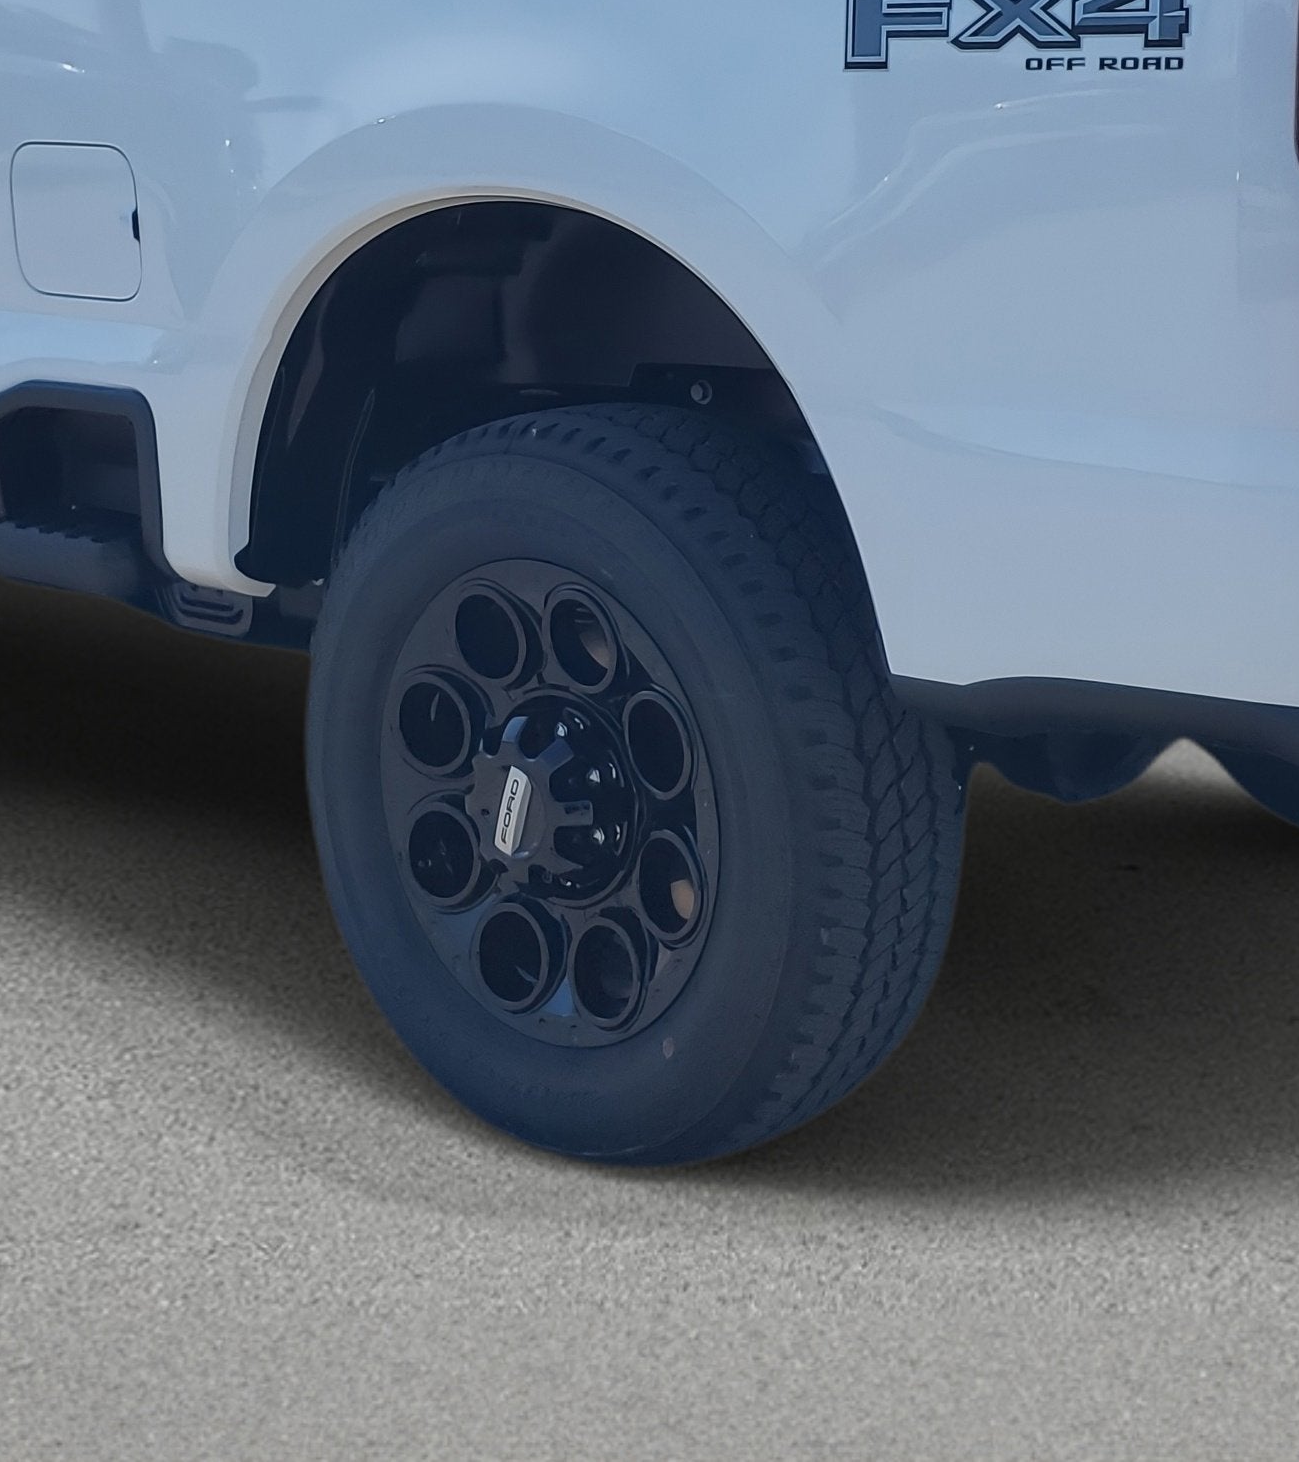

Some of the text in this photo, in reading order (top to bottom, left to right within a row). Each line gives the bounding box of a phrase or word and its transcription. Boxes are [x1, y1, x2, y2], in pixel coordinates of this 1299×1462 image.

[1024, 55, 1185, 72] OFF ROAD
[500, 778, 520, 845] FORD
